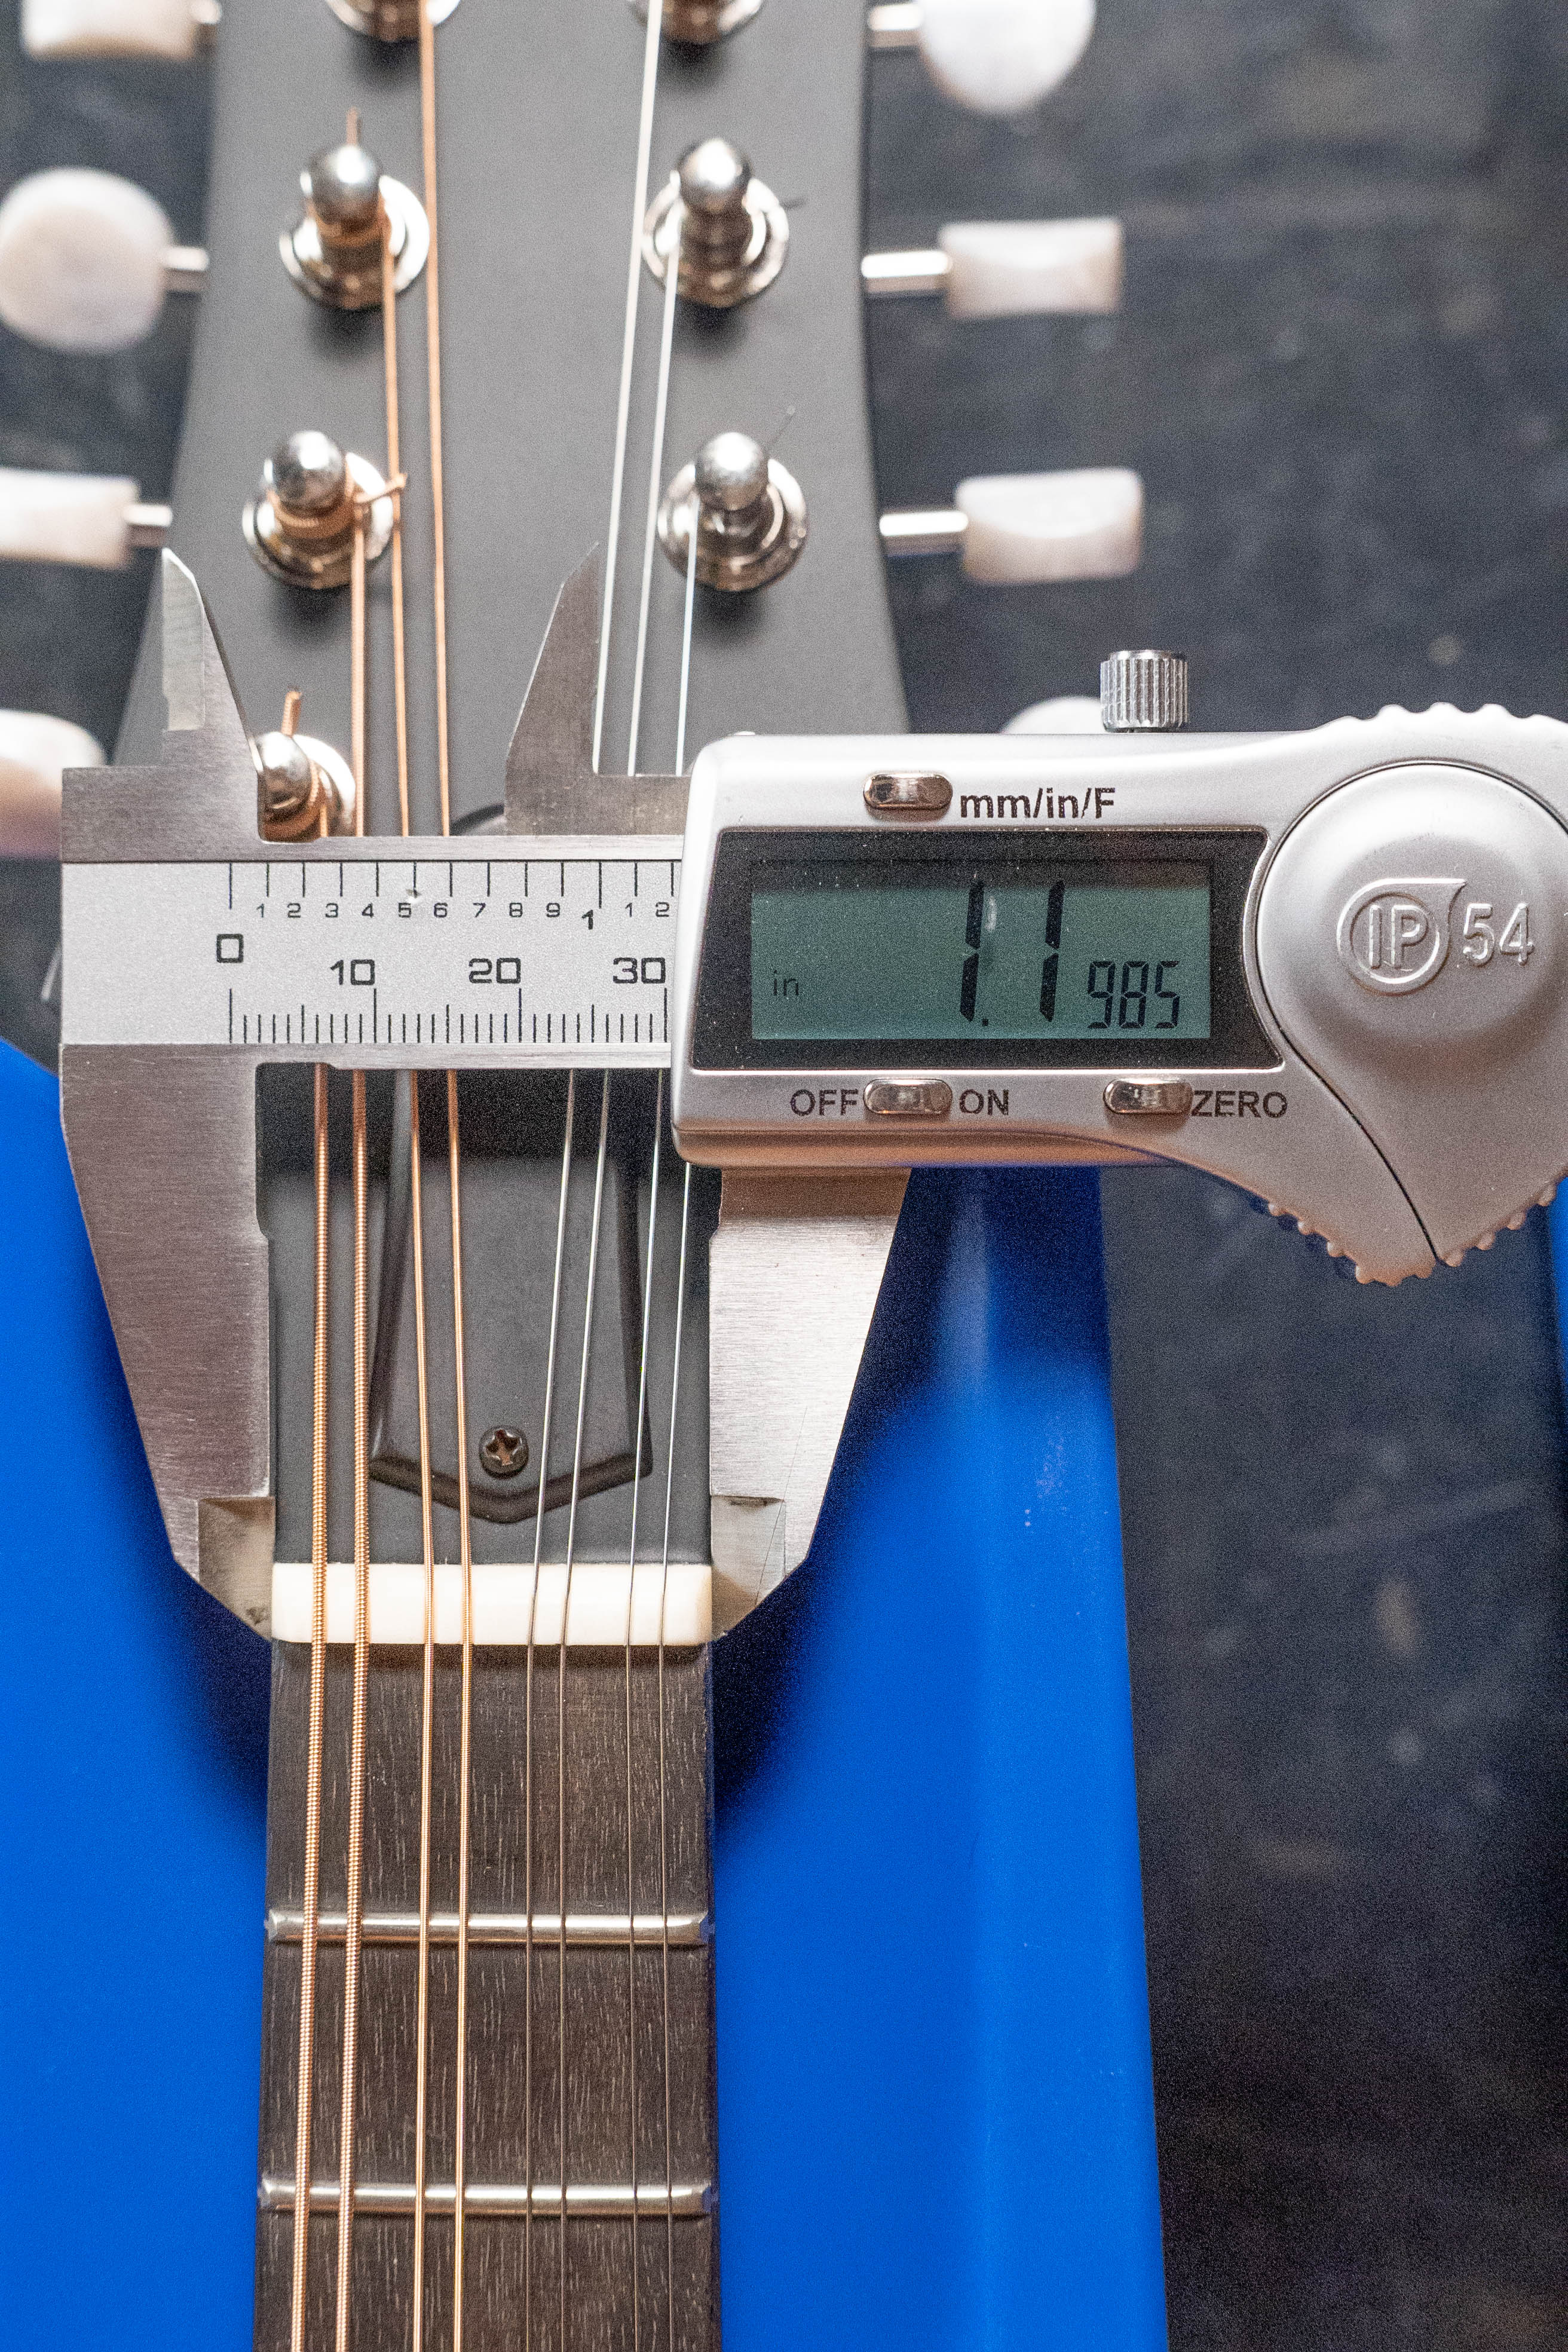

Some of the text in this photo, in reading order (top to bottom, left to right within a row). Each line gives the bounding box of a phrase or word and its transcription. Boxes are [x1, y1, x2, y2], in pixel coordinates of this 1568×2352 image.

[960, 788, 1116, 819] mm/in/F
[256, 902, 670, 930] 1 2 3 4 5 6 7 8 9 1 1 2
[216, 933, 244, 963] 0
[1367, 902, 1535, 969] IP 54
[330, 957, 666, 986] 10 20 30
[772, 969, 800, 997] in
[789, 1088, 1009, 1117] OFF ON
[1189, 1089, 1288, 1119] ZERO
